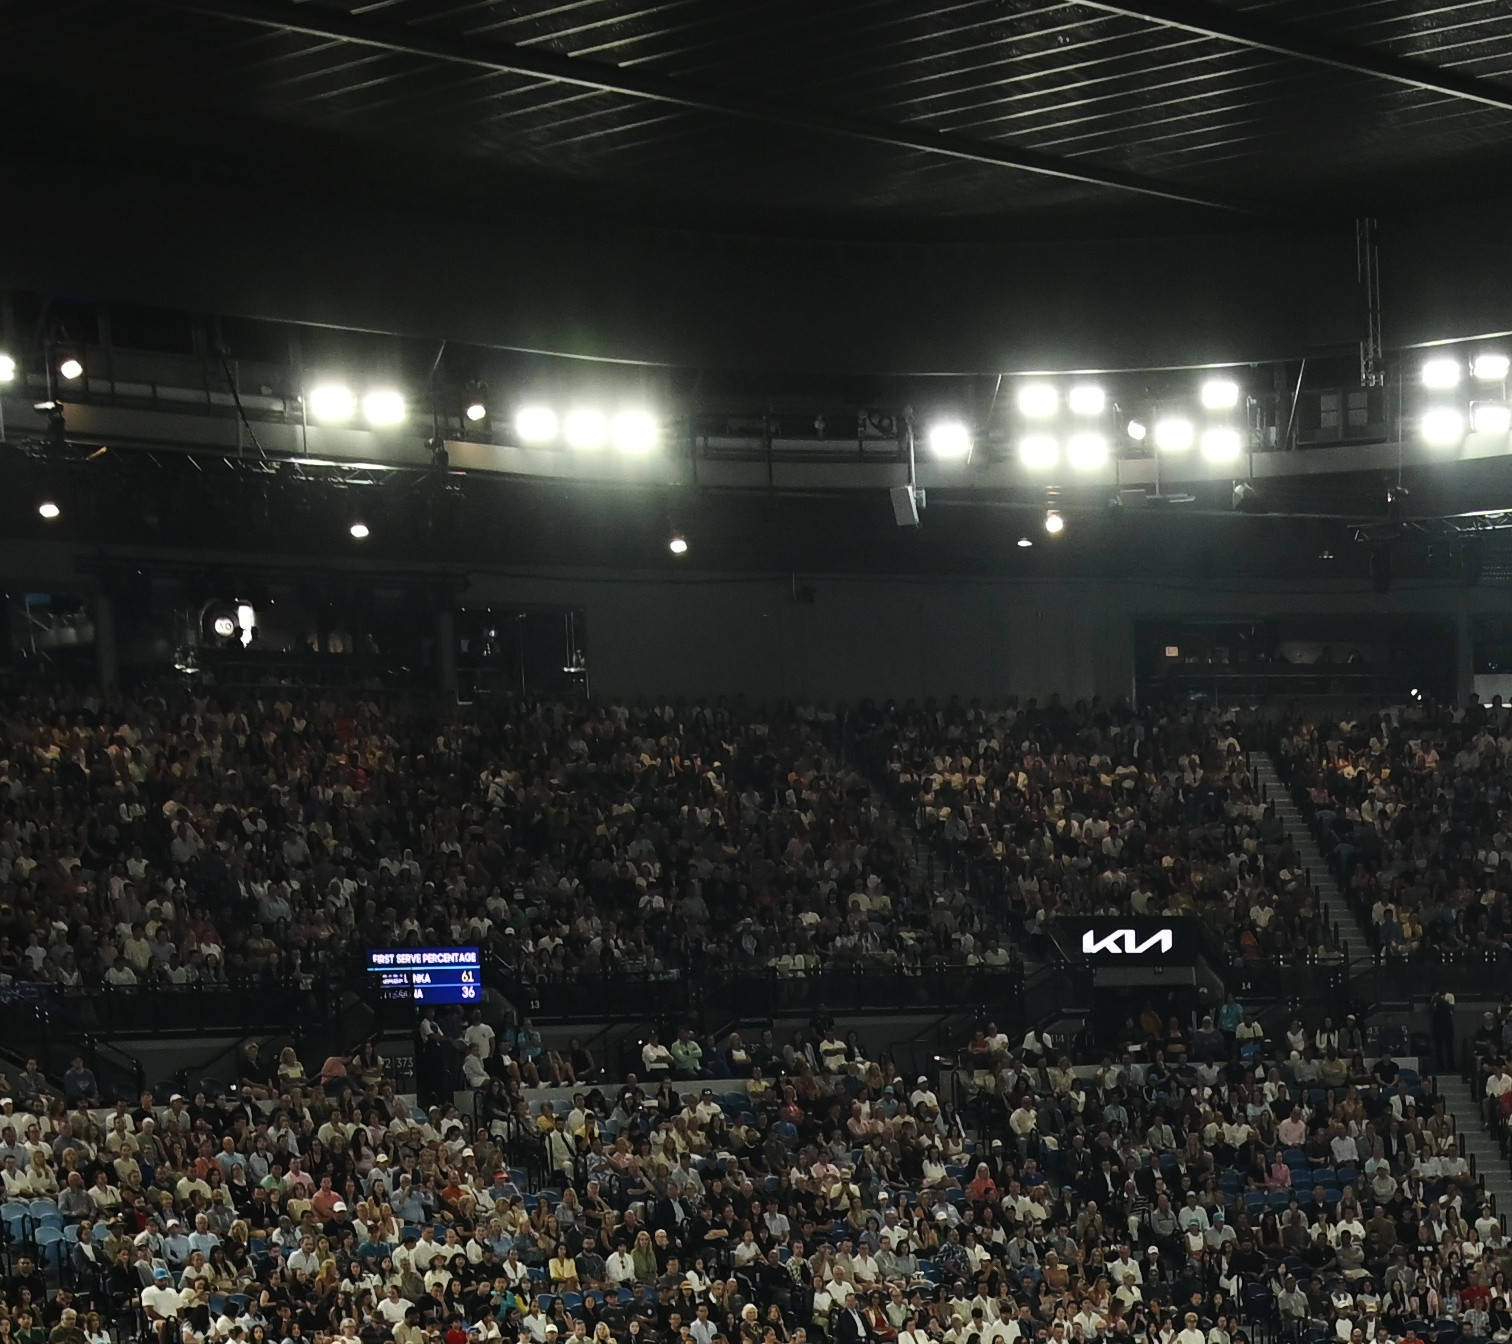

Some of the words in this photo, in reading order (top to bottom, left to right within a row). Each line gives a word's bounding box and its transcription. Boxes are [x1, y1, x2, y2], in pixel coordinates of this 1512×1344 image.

[1083, 930, 1173, 954] KIA
[372, 953, 394, 965] FIRST
[396, 953, 422, 964] SERVE
[422, 951, 477, 963] PERCENTAGE
[461, 970, 475, 983] 61
[461, 985, 476, 998] 36
